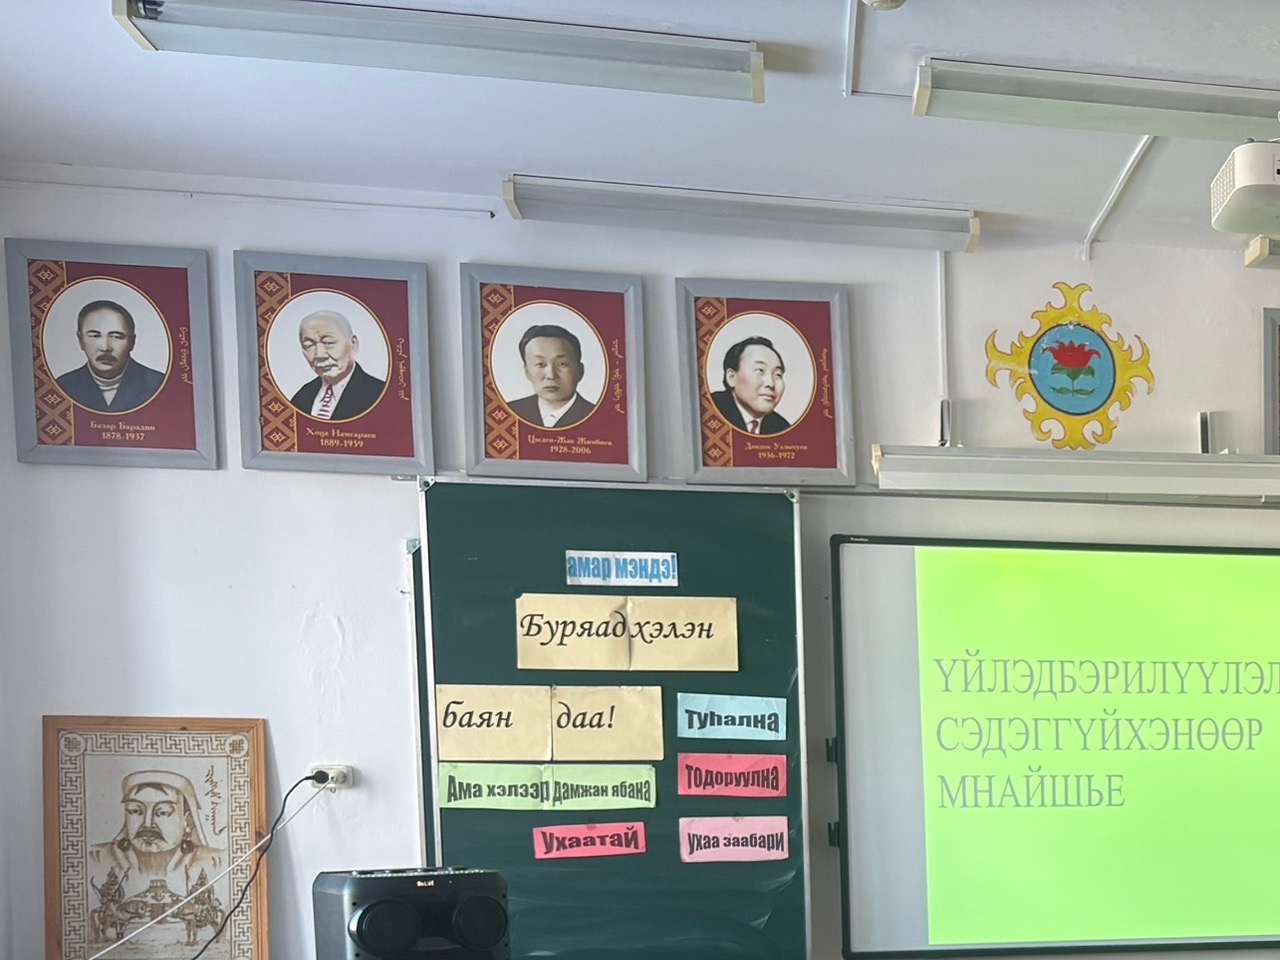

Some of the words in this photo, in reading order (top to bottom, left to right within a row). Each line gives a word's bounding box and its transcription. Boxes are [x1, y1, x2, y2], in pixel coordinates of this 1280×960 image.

[102, 431, 145, 441] 1878-1937
[320, 438, 364, 448] 1889-1959
[550, 445, 592, 455] 1928-2006
[758, 451, 796, 460] 1936-1972
[567, 556, 611, 580] амар
[615, 554, 677, 583] мэндэ!
[520, 610, 627, 646] Буряад
[630, 620, 715, 645] хэлэн
[442, 700, 514, 729] баян
[556, 701, 616, 729] даа!
[936, 708, 1264, 758] СЭДЭГГҮЙХЭНӨӨР
[447, 775, 483, 803] Ама
[487, 781, 550, 803] хэлээр
[552, 780, 608, 807] дамжан
[611, 779, 651, 803] ябана
[938, 764, 1127, 809] МНАЙШЬЕ
[723, 831, 784, 853] заабари
